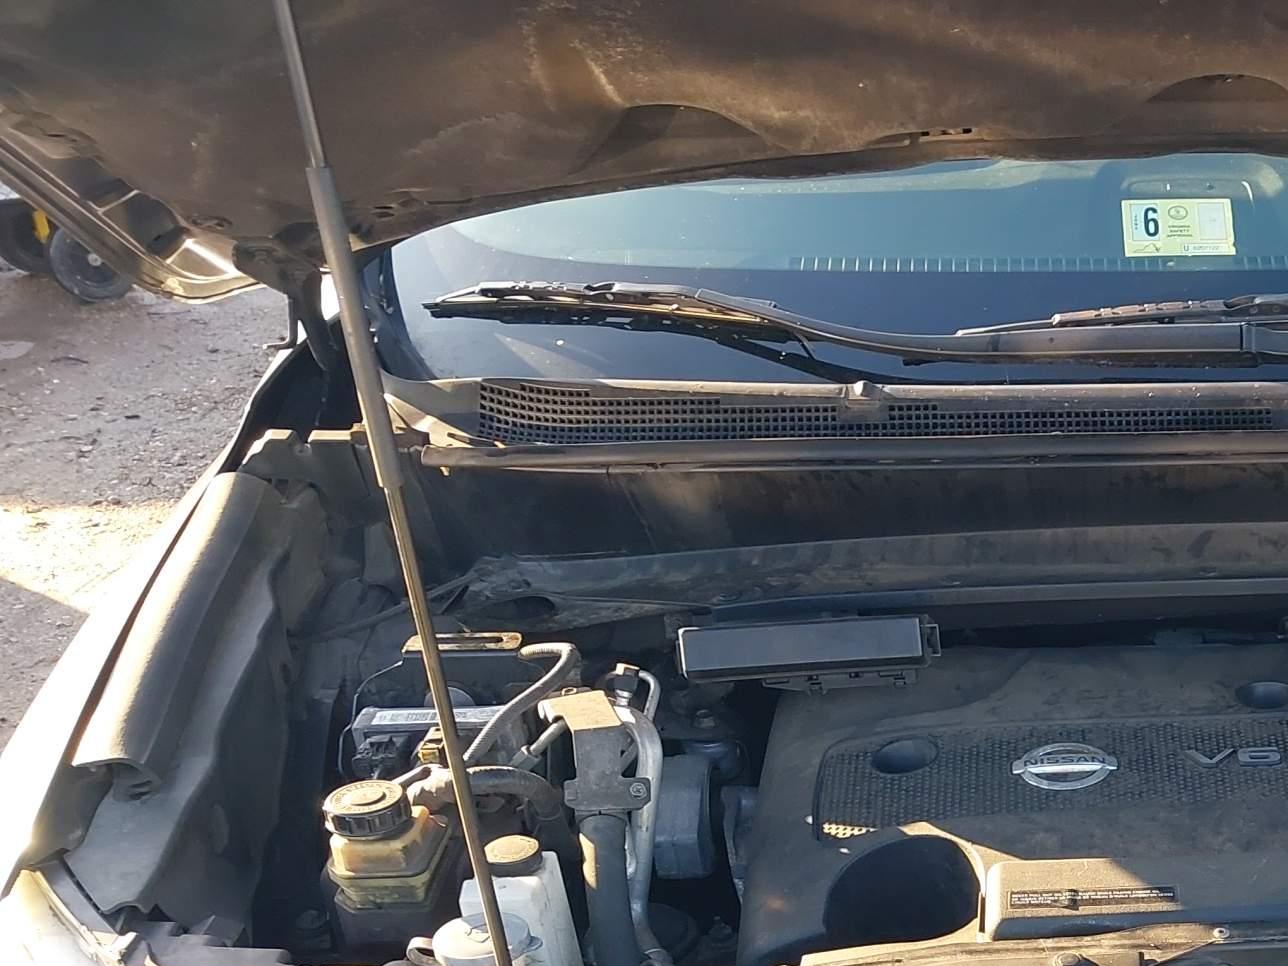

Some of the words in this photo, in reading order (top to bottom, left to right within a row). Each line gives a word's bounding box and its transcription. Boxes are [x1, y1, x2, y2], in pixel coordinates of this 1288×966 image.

[1144, 207, 1159, 237] 6
[1023, 754, 1106, 767] NISSAN
[1185, 747, 1282, 768] V6
